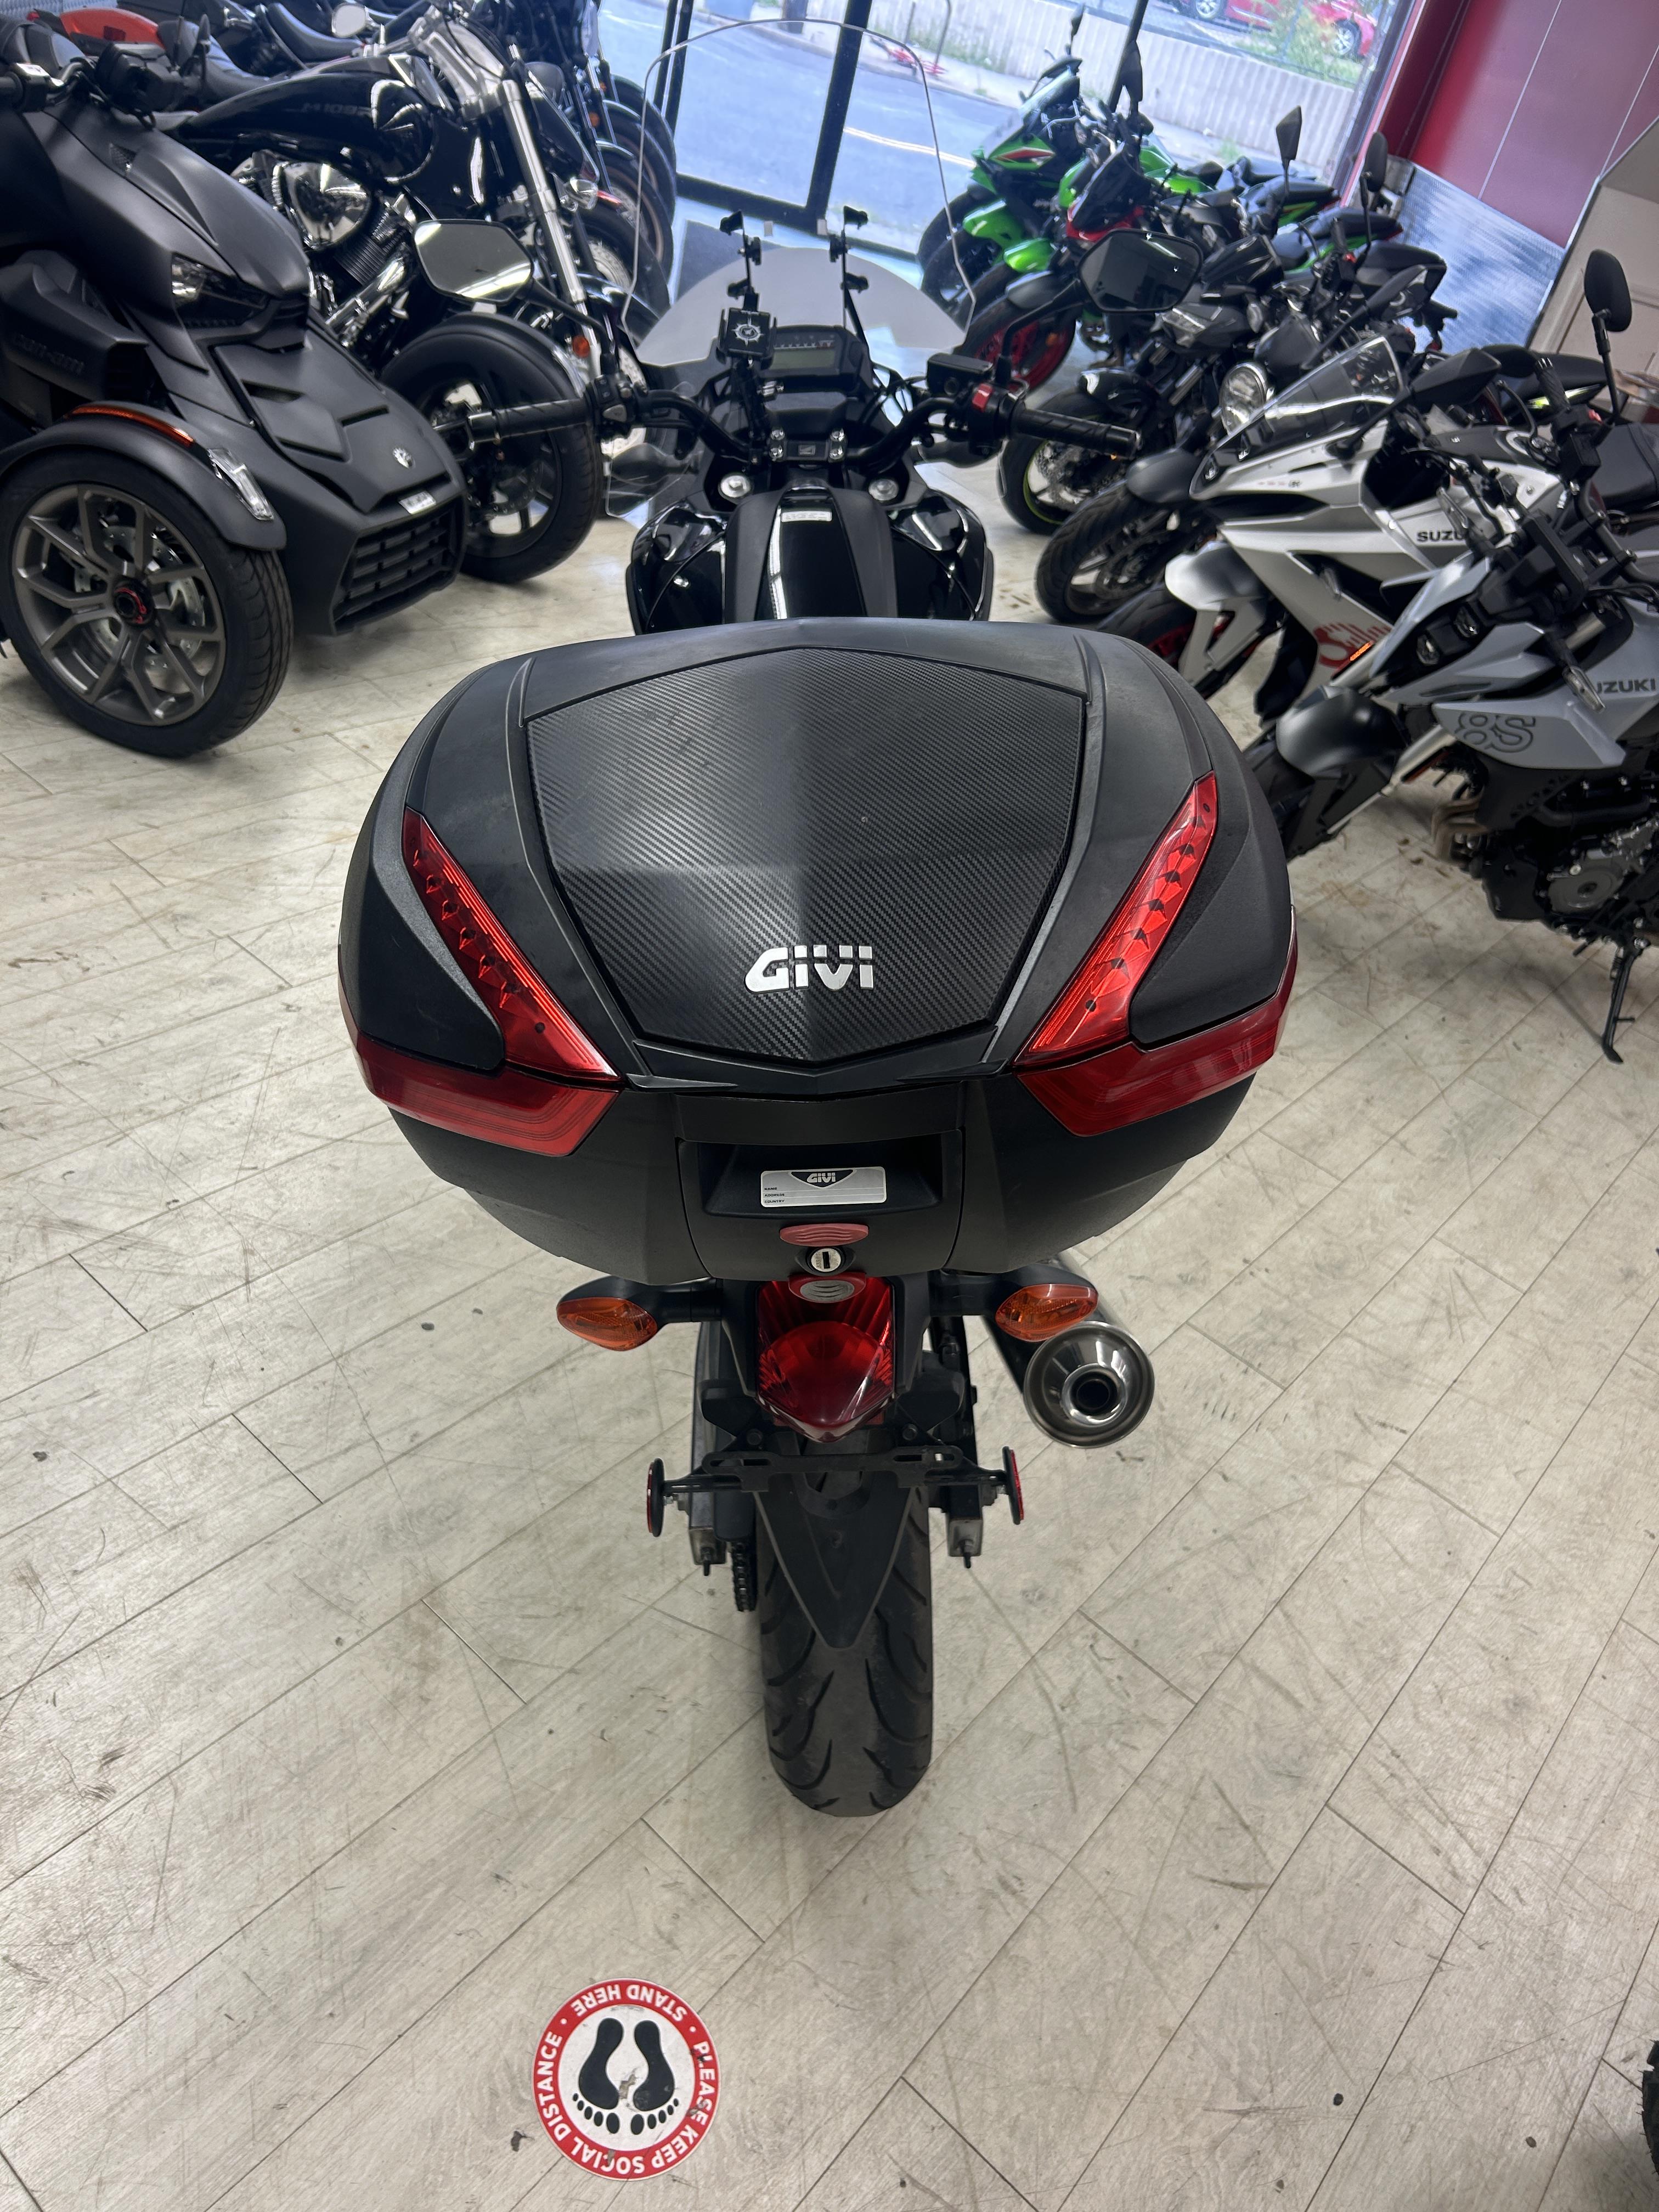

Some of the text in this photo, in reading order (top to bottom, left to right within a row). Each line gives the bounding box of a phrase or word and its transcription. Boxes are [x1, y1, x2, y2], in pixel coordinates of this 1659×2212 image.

[1454, 712, 1536, 753] 8S
[745, 945, 873, 993] GIVI
[806, 1172, 836, 1183] GIVI
[571, 1984, 687, 2022] STAND HERE
[537, 2031, 715, 2175] PLEASE KEEP SOCIAL DISTANCE
